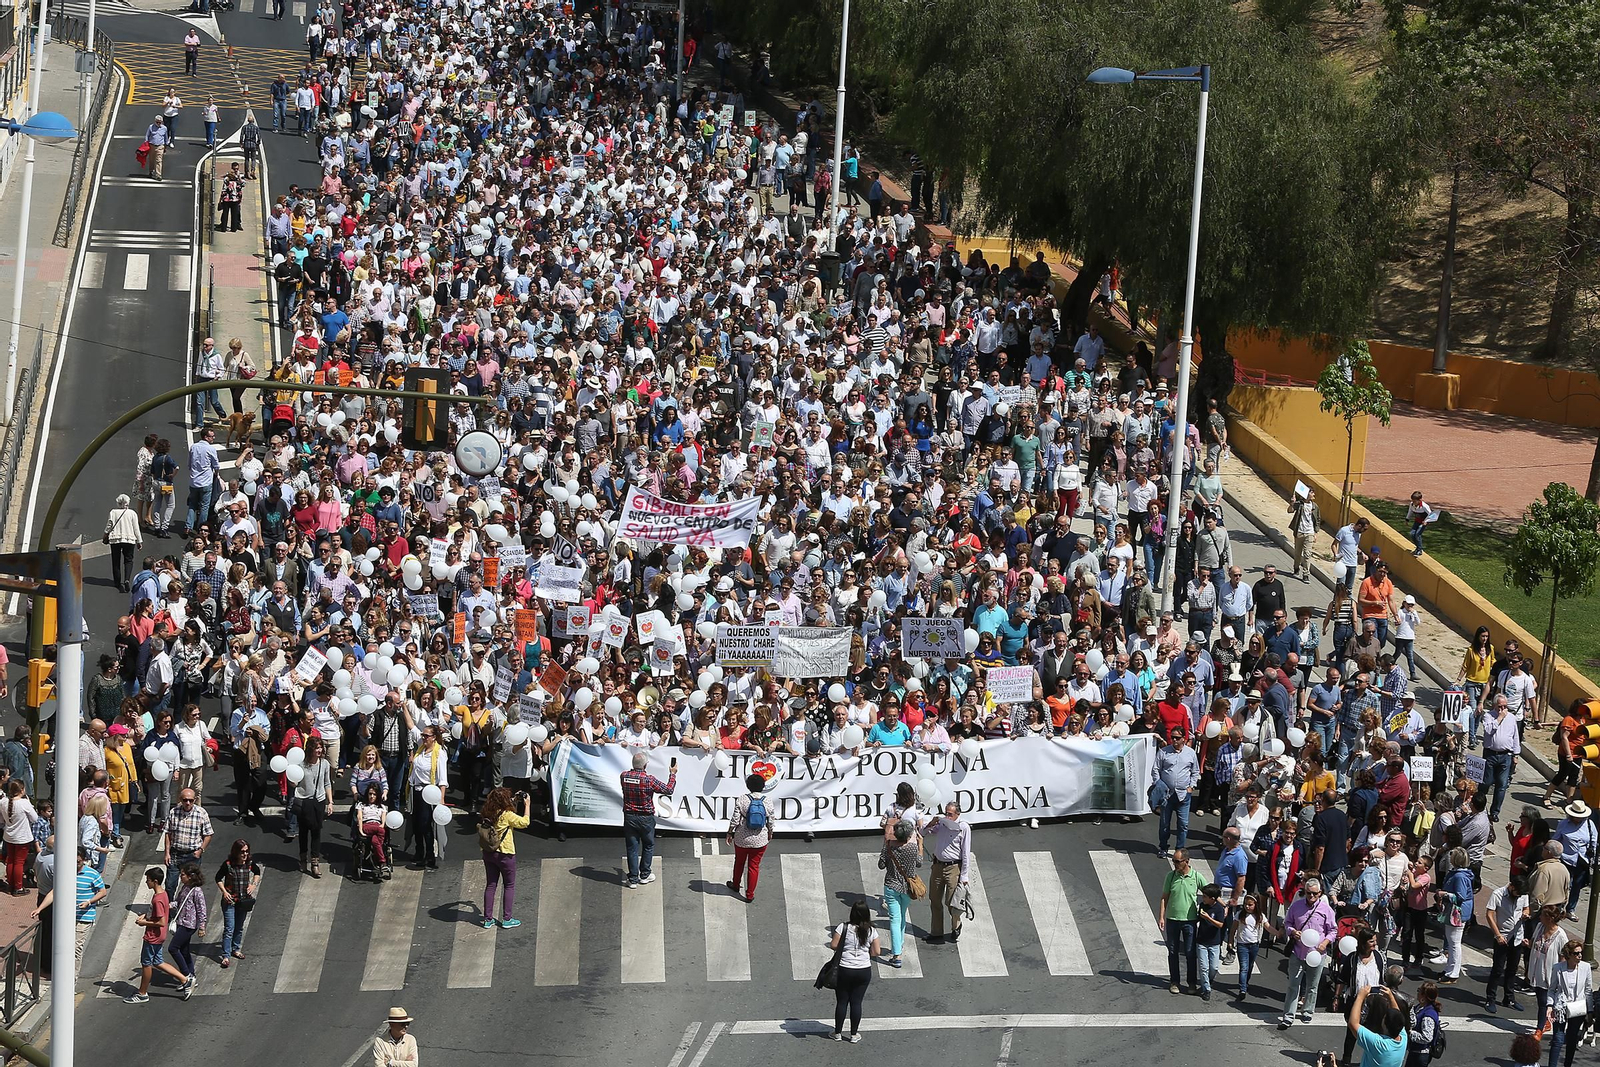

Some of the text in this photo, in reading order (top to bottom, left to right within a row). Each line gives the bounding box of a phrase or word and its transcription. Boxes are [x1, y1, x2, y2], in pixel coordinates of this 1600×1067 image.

[414, 482, 434, 502] NO
[628, 510, 754, 530] NUEVO CENTRO DE
[624, 523, 679, 542] SALUD
[552, 535, 573, 559] NO
[726, 627, 771, 637] QUEREMOS
[719, 638, 775, 648] NUESTRO CHARE
[944, 650, 962, 658] VIDA
[1442, 694, 1461, 721] NO
[715, 747, 990, 782] HLVA, POR UNA
[657, 795, 803, 820] SANID
[953, 785, 1051, 813] DIGNA
